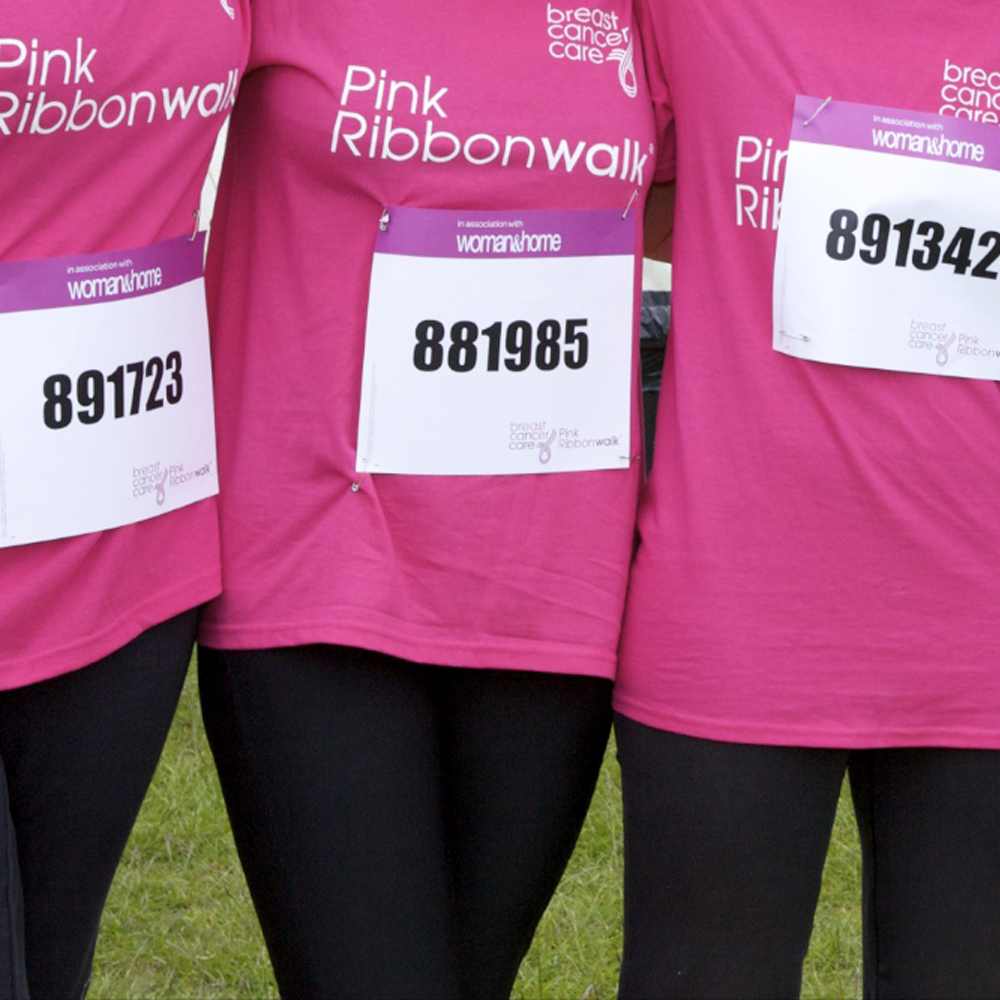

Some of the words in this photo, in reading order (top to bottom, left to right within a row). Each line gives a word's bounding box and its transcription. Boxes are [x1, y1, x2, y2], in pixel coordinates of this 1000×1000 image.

[547, 2, 618, 30] breast
[547, 24, 629, 47] cancer
[549, 41, 604, 64] care
[340, 65, 448, 118] Pink
[882, 117, 926, 129] association
[927, 122, 943, 131] with
[330, 110, 648, 186] Ribbonwalk
[872, 128, 984, 162] woman&home
[465, 219, 507, 228] association
[508, 219, 524, 228] with
[456, 230, 562, 253] woman&home
[67, 267, 162, 300] woman&home
[910, 319, 946, 331] breast
[909, 330, 948, 341] cancer
[909, 340, 933, 349] care
[958, 333, 979, 345] Pink
[413, 318, 588, 372] 881985
[43, 350, 183, 430] 891723
[510, 420, 546, 431] breast
[510, 431, 548, 441] cancer
[558, 436, 619, 449] Ribbonwalk
[508, 441, 535, 450] care
